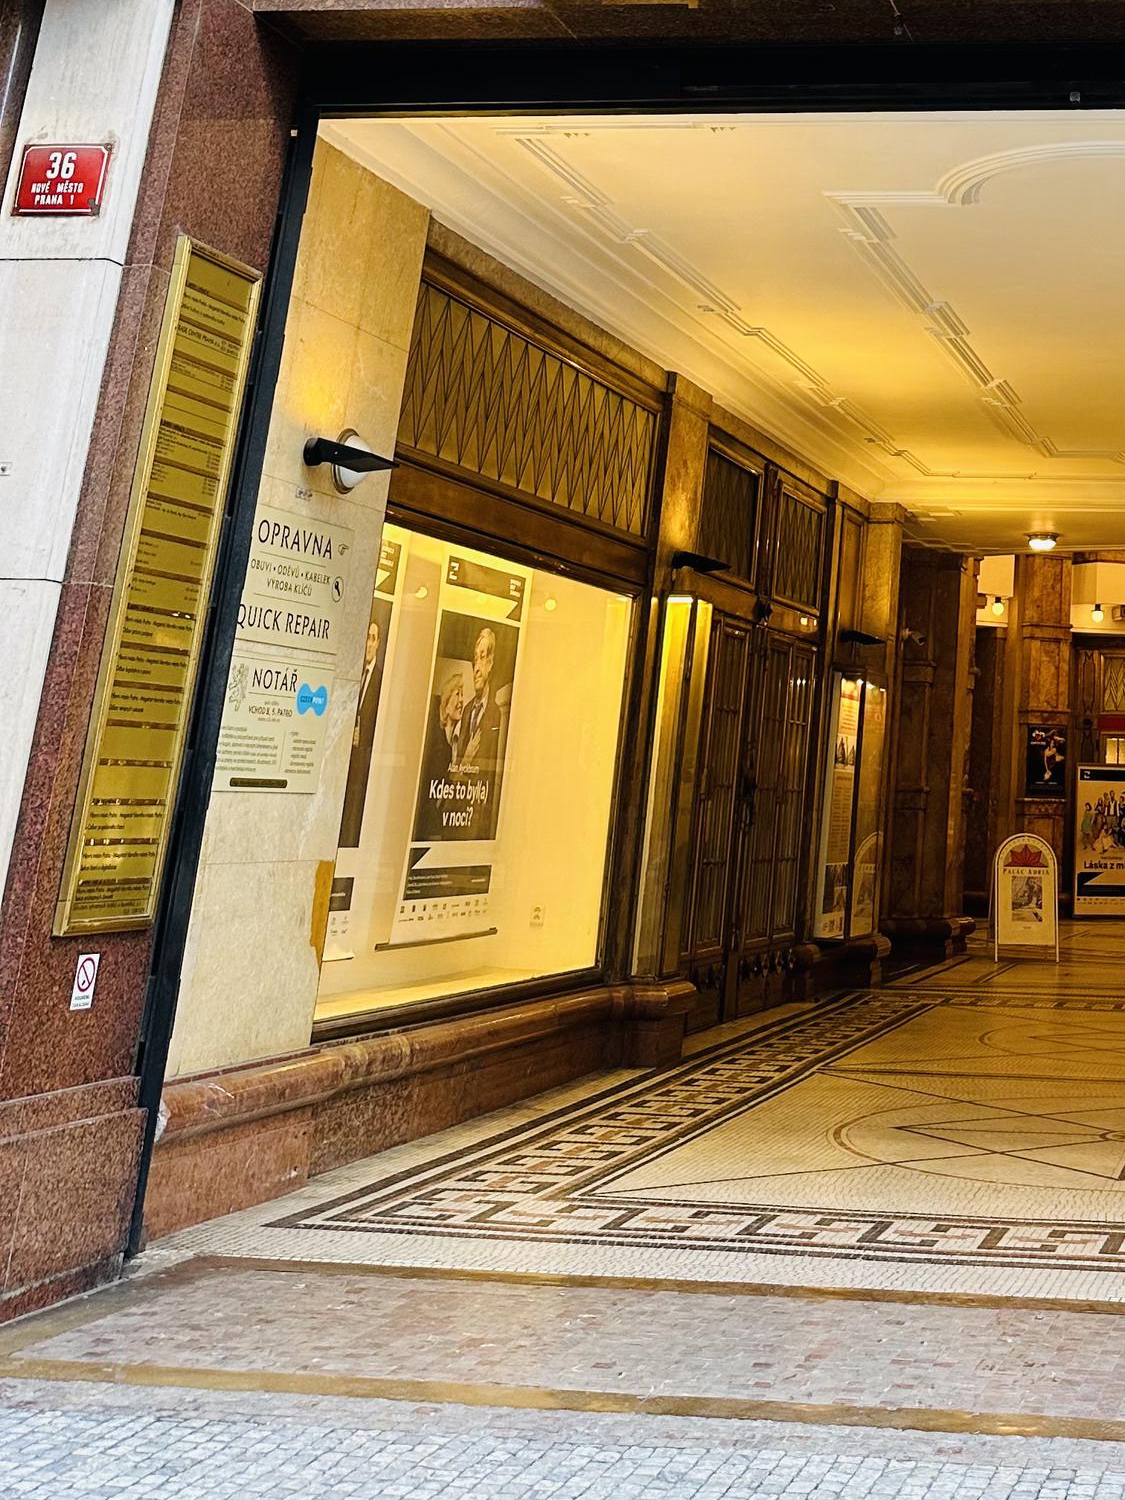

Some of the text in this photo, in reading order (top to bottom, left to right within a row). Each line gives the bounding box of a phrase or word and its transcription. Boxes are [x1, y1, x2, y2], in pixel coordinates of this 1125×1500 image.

[46, 152, 77, 179] 36
[31, 180, 84, 193] NOVÉ MĚSTO
[34, 194, 75, 206] PRAHA 1
[258, 519, 332, 560] OPRAVNA
[250, 558, 272, 572] OBUVI
[304, 570, 331, 585] KABELEK
[266, 577, 293, 592] VÝROBA
[237, 603, 330, 640] QUICK REPAIR
[252, 666, 298, 693] NOTÁŘ
[429, 777, 489, 804] Kdes to byl(a)
[442, 806, 474, 828] v noci?
[1027, 867, 1050, 876] ADRIA
[1084, 860, 1108, 870] Láska
[1109, 862, 1115, 870] z
